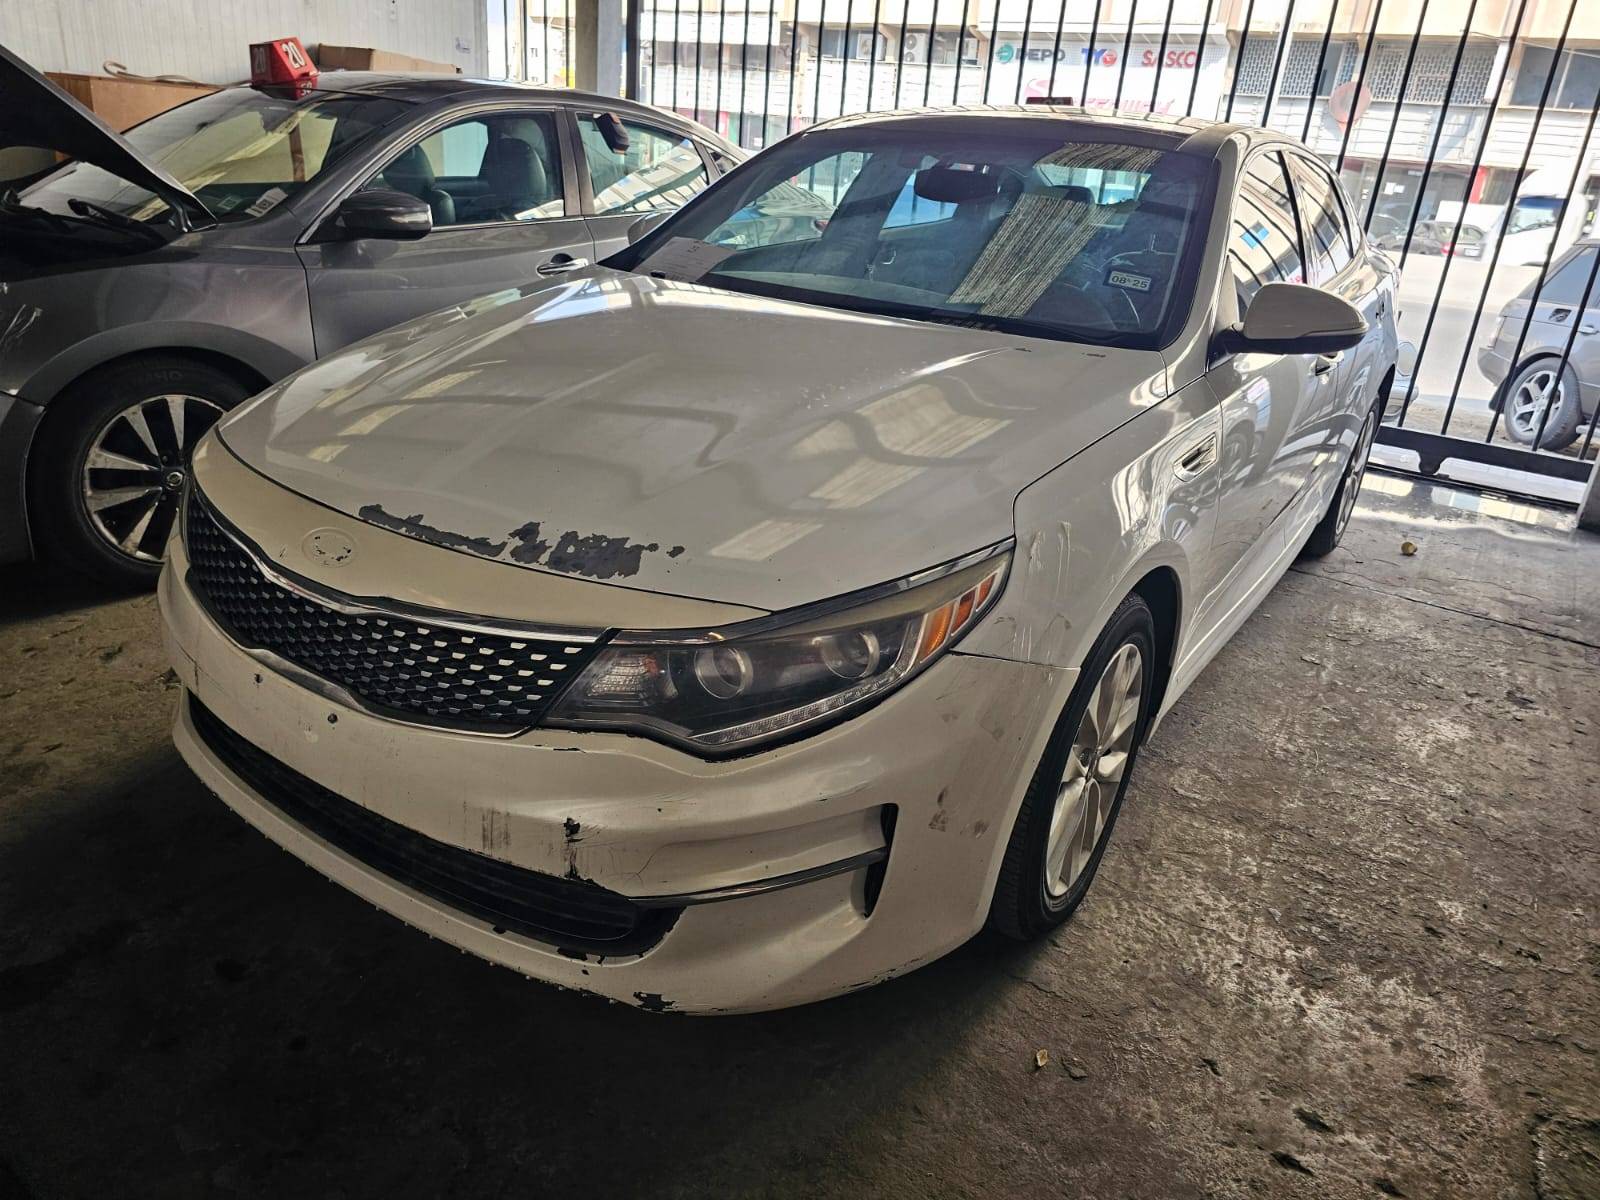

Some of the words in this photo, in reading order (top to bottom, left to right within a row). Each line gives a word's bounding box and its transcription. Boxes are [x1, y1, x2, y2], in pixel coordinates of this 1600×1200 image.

[281, 41, 306, 68] 20
[1111, 275, 1127, 284] 08
[1132, 279, 1148, 288] 25
